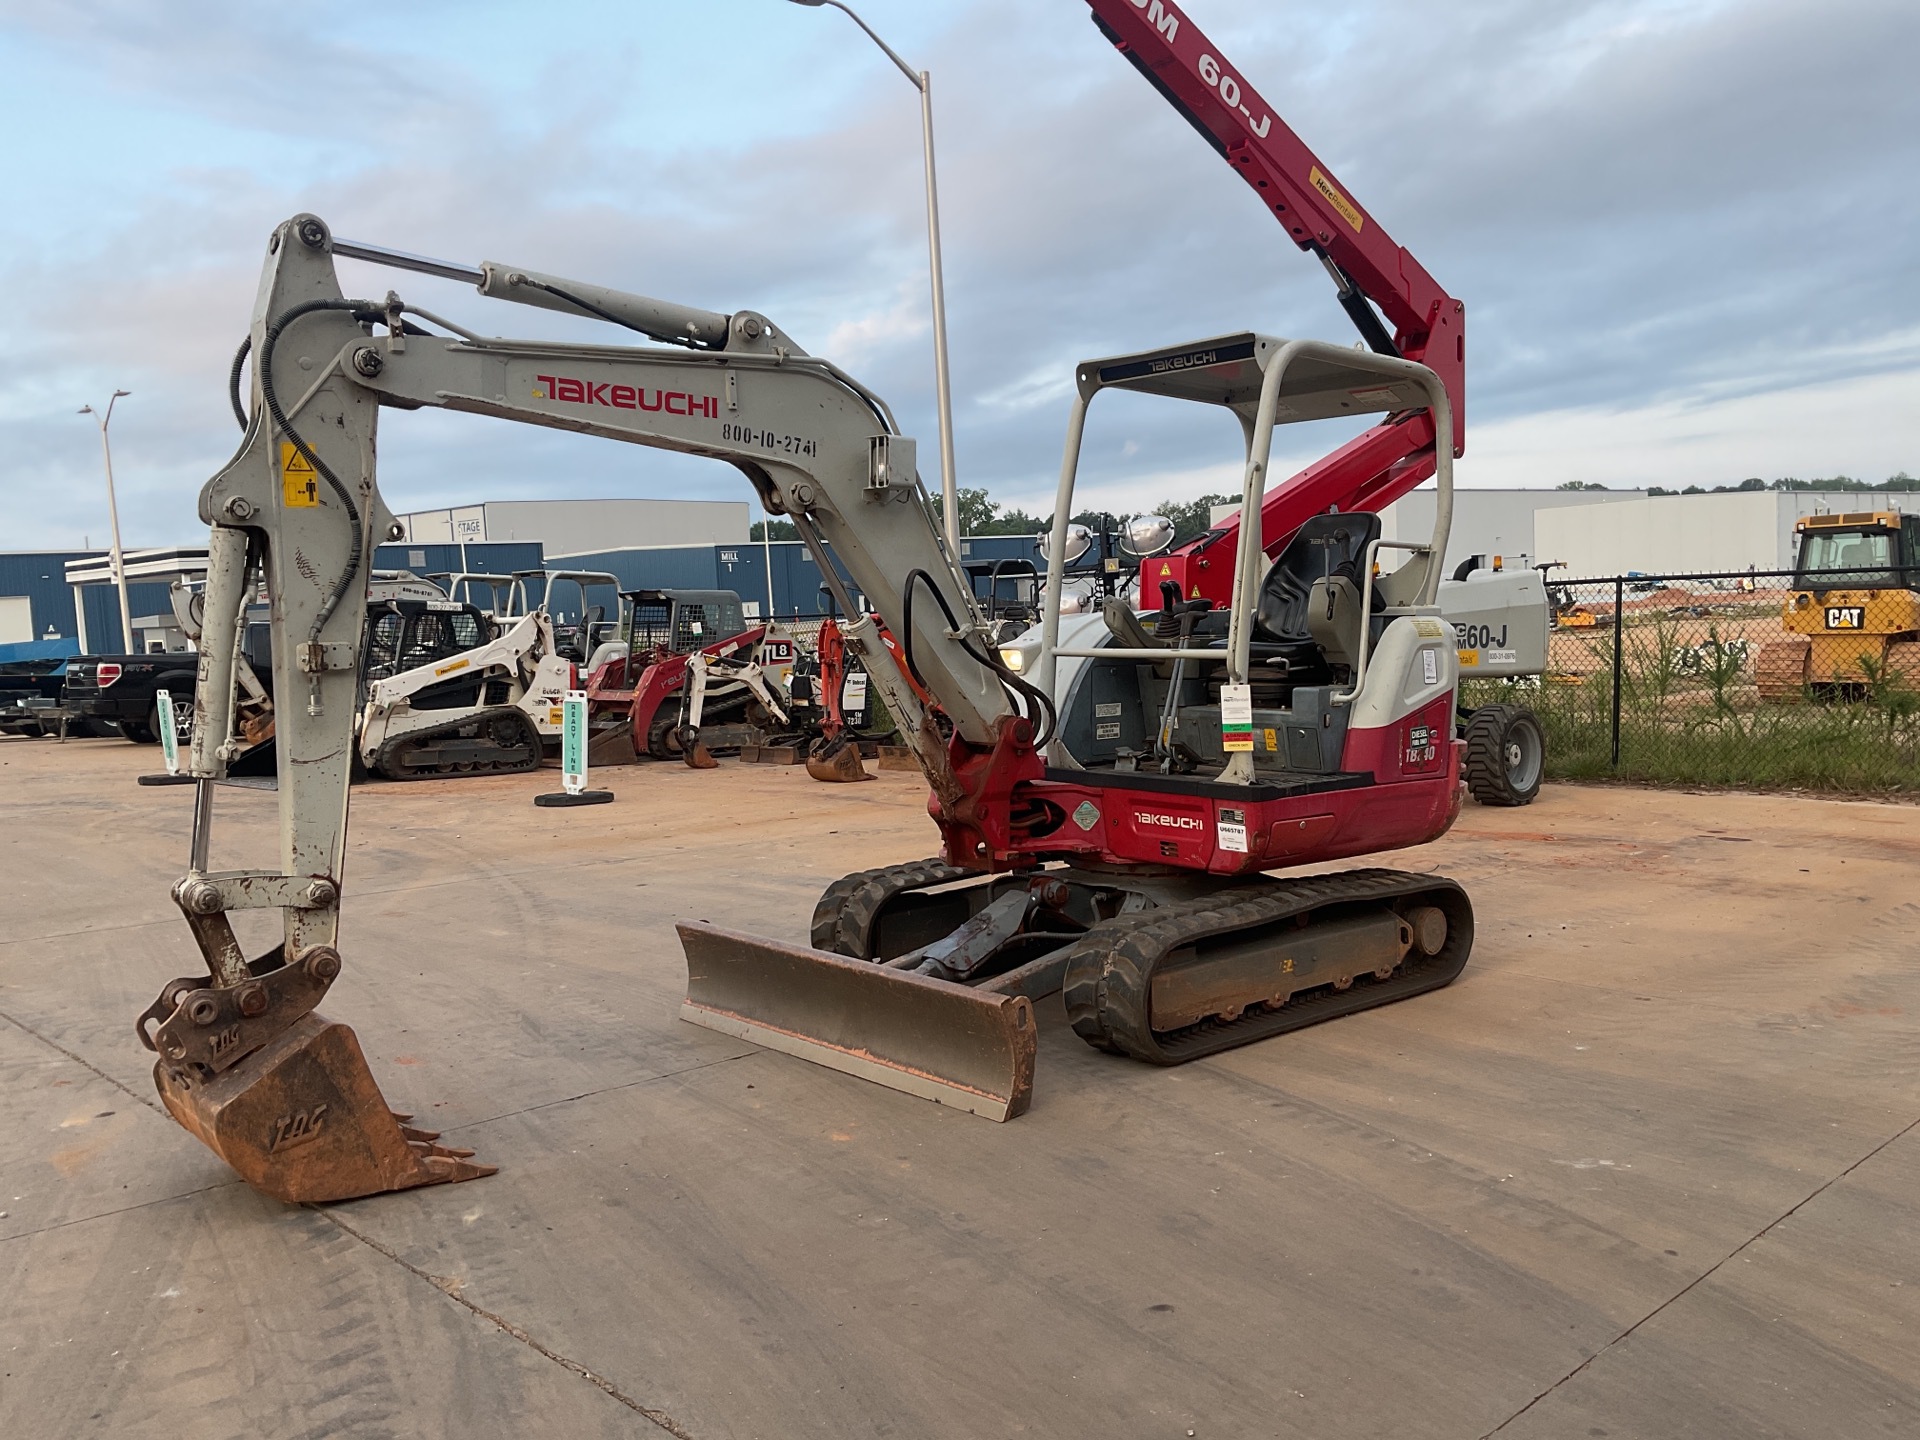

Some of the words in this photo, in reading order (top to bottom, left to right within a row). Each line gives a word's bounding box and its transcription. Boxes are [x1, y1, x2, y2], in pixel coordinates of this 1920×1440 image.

[1198, 53, 1272, 139] 60-J
[1316, 178, 1356, 225] HercRentals
[722, 423, 816, 458] 800-10-2741
[721, 551, 739, 562] MILL
[727, 562, 733, 573] 1
[47, 624, 56, 633] A
[1828, 608, 1861, 628] CAT
[1467, 624, 1507, 649] 60-J
